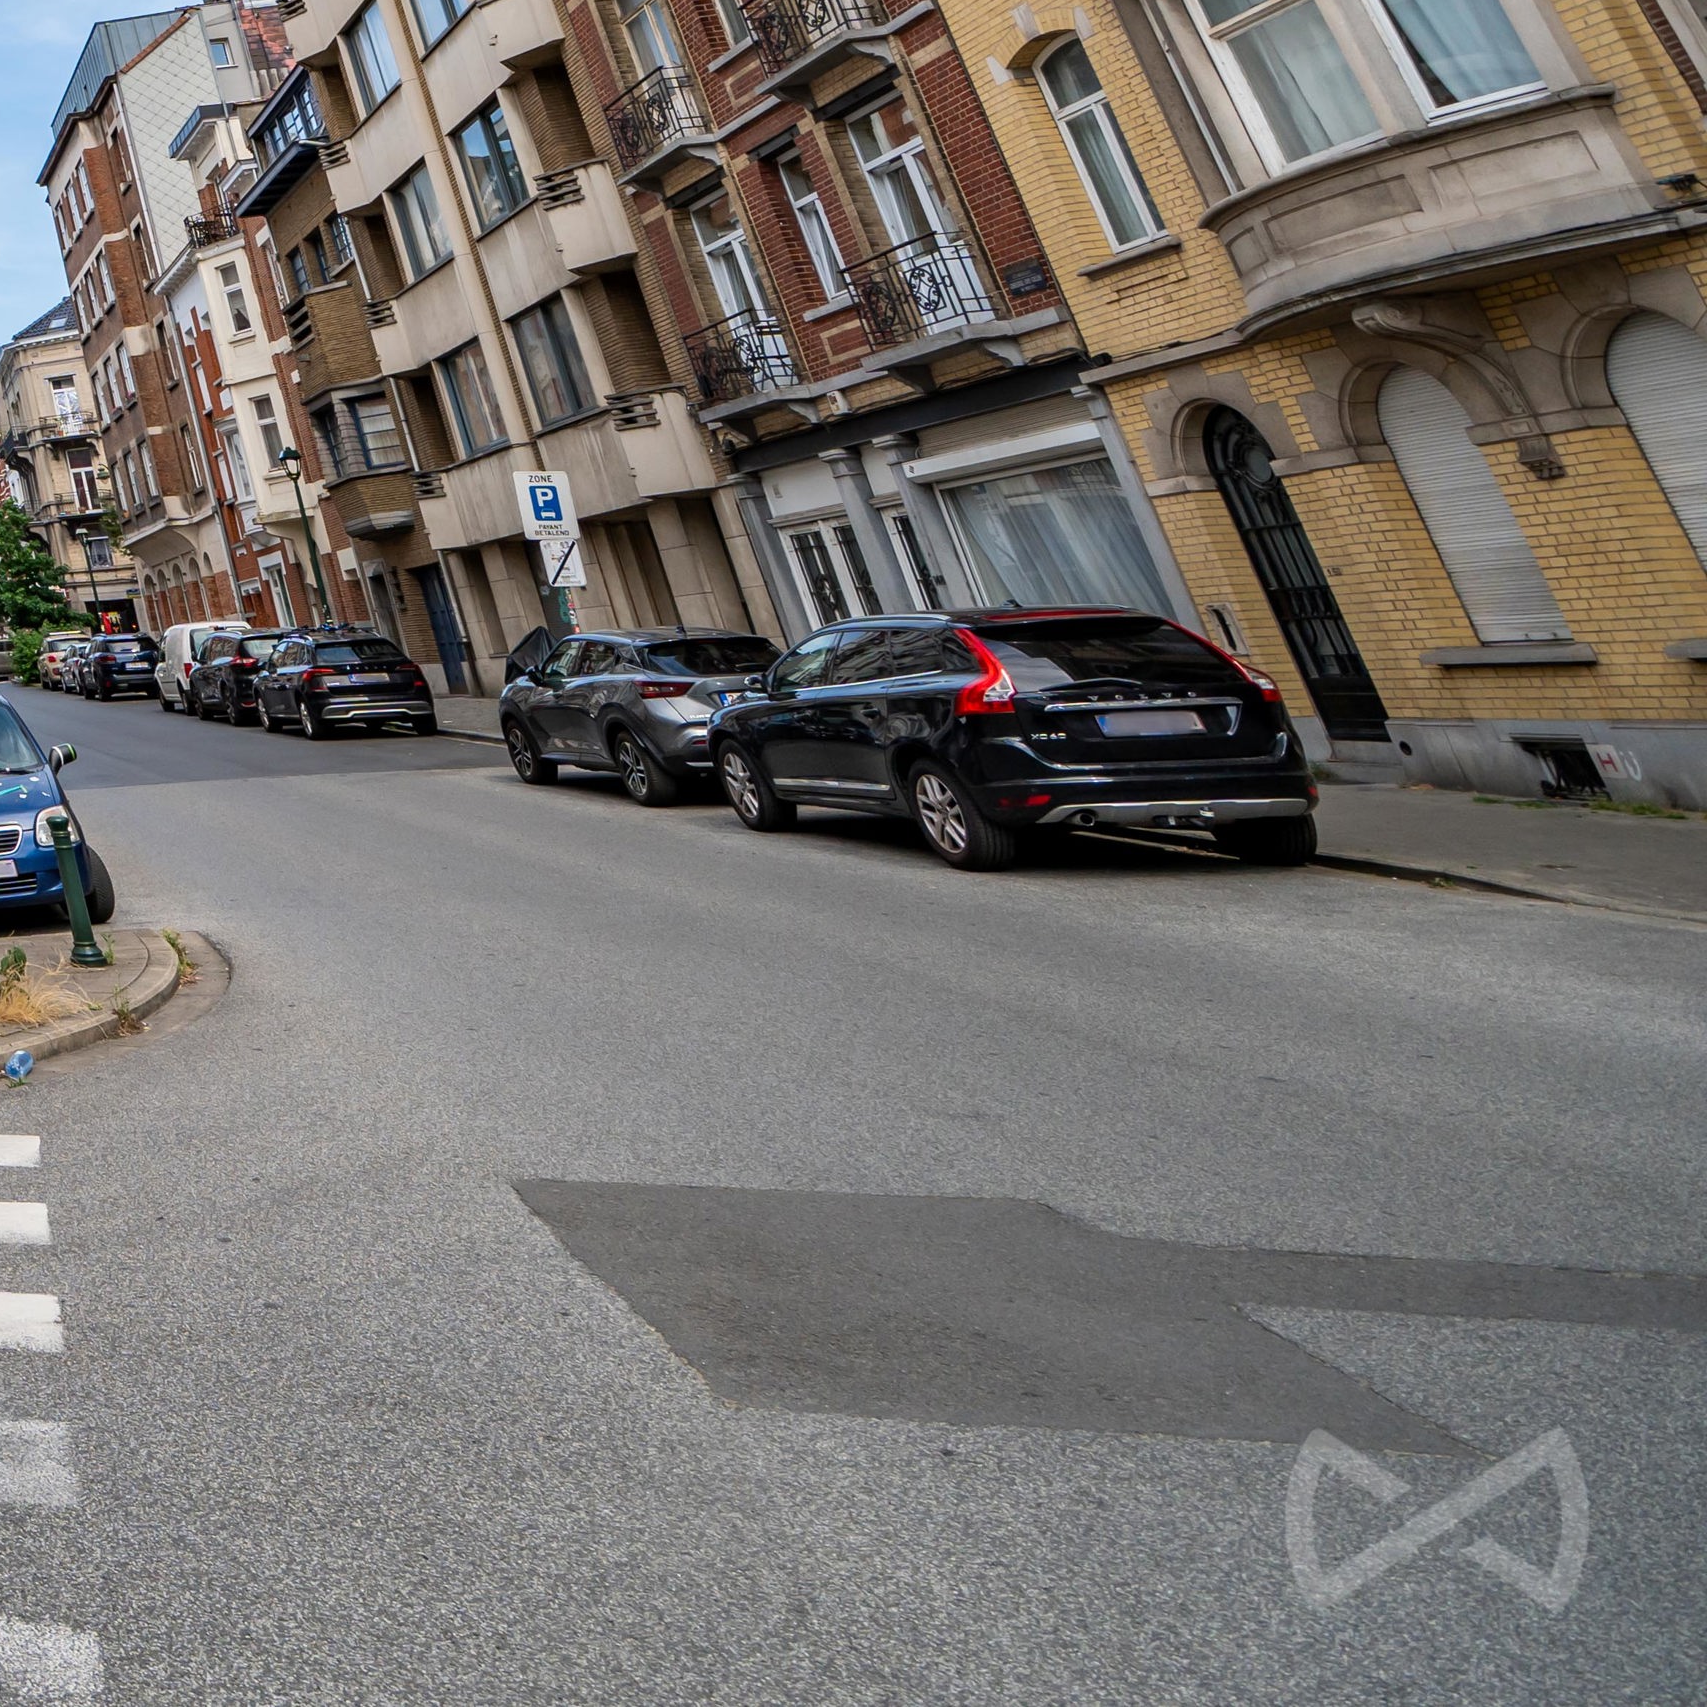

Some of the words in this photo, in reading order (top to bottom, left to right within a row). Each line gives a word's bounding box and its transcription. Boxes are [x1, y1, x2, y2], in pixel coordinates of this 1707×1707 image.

[529, 475, 553, 483] ZONE
[535, 488, 554, 507] P
[1088, 692, 1197, 701] VOLVO
[1030, 732, 1067, 740] XC60
[1596, 753, 1618, 772] H
